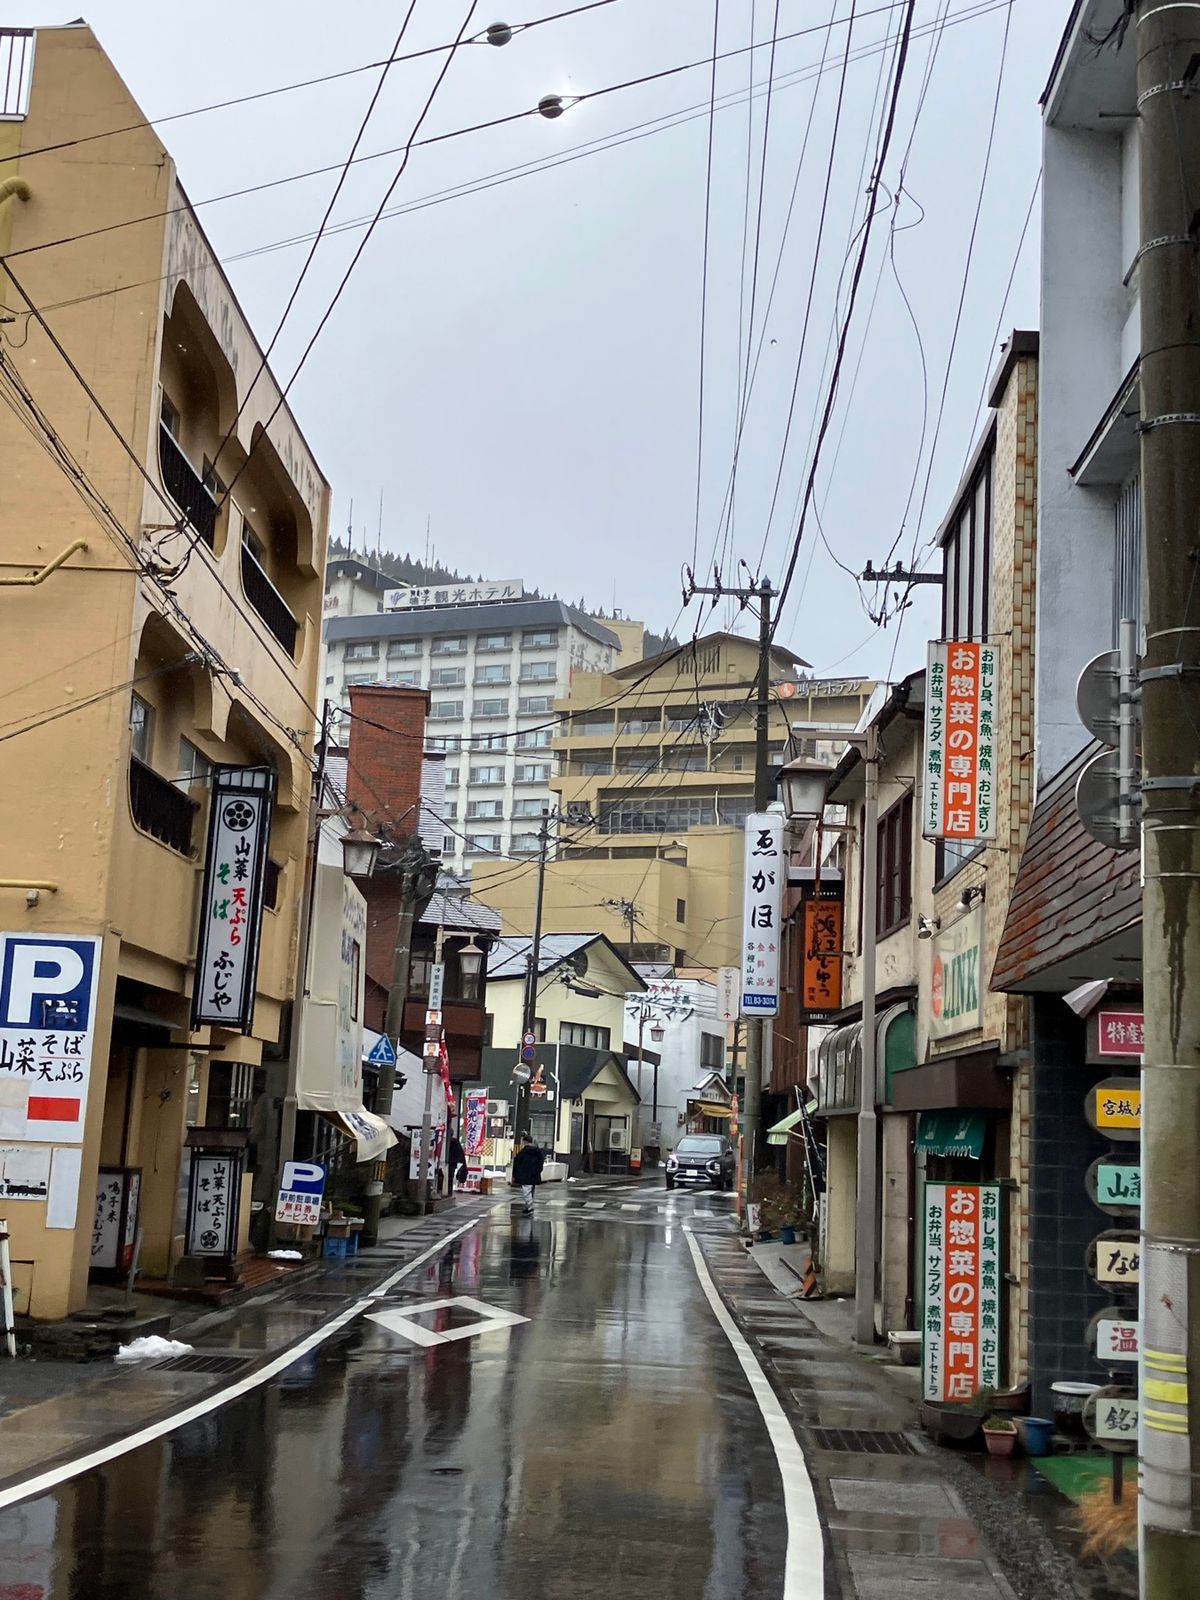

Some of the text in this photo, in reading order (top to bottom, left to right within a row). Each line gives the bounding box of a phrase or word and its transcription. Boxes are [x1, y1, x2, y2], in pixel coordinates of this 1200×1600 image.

[796, 681, 862, 698] 鳴子ホテル
[946, 648, 976, 833] お惣菜の専門店
[212, 863, 231, 920] そば
[229, 836, 251, 946] 山菜 天ぷら
[751, 829, 778, 929] ゑがほ
[7, 944, 85, 1023] P
[209, 950, 235, 1013] ふじや
[943, 944, 979, 1020] LINK
[37, 1061, 84, 1083] 天ぷら
[41, 1034, 86, 1055] そば
[197, 1178, 211, 1212] そば
[212, 1162, 226, 1190] 山菜
[281, 1161, 325, 1190] P
[277, 1209, 317, 1223] サービス中
[948, 1189, 976, 1398] お惣菜の専門店
